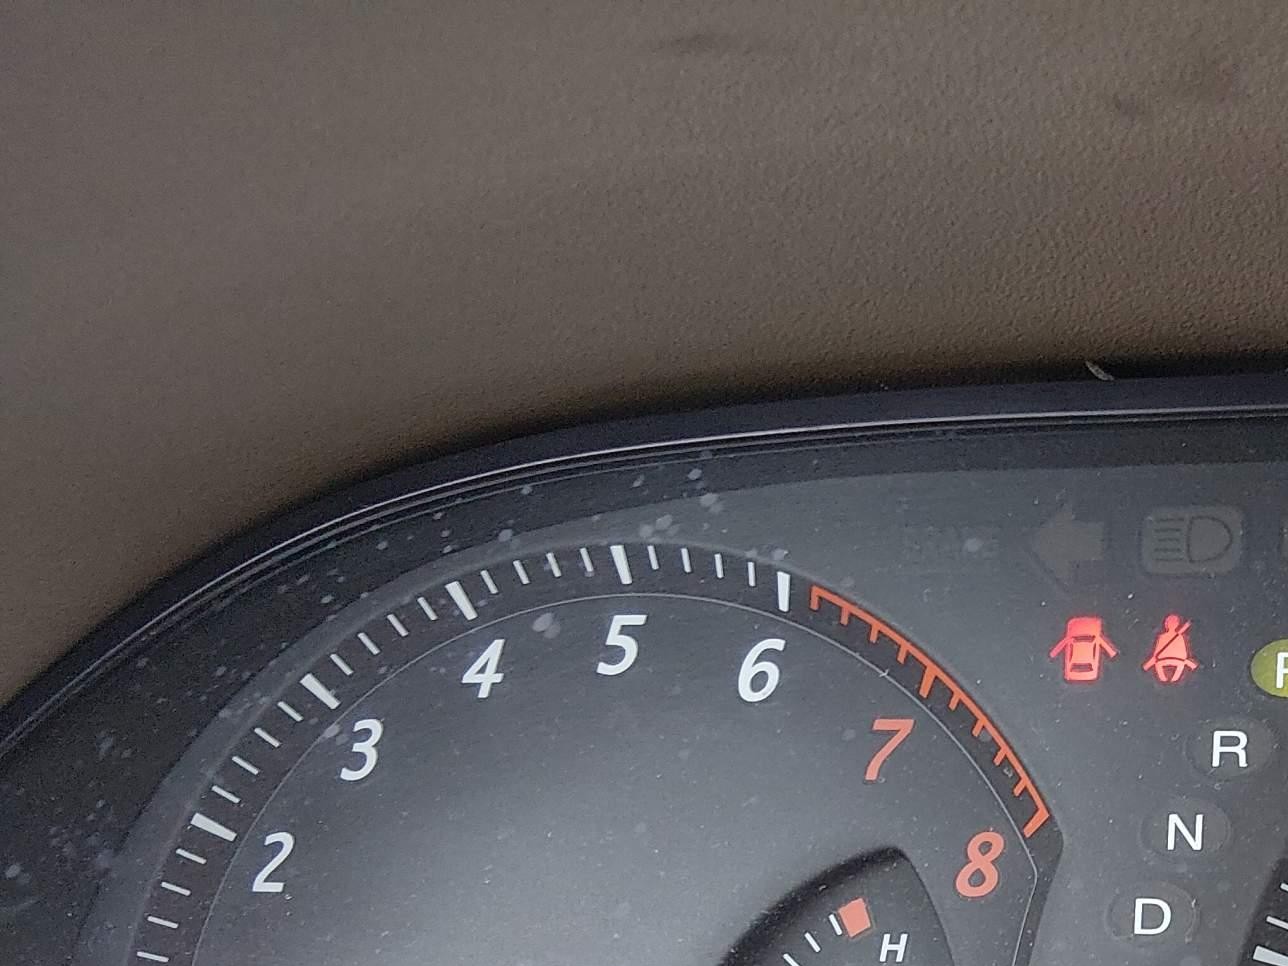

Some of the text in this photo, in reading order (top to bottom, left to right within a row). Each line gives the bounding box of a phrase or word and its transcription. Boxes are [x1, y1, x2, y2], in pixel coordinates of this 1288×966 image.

[461, 637, 505, 699] 4
[596, 613, 647, 677] 5
[737, 638, 786, 703] 6
[340, 718, 384, 782] 3
[864, 717, 914, 781] 7
[1210, 730, 1249, 768] R
[252, 831, 295, 894] 2
[1166, 812, 1205, 852] N
[955, 831, 1005, 898] 8
[1133, 897, 1172, 936] D
[879, 933, 908, 964] H
